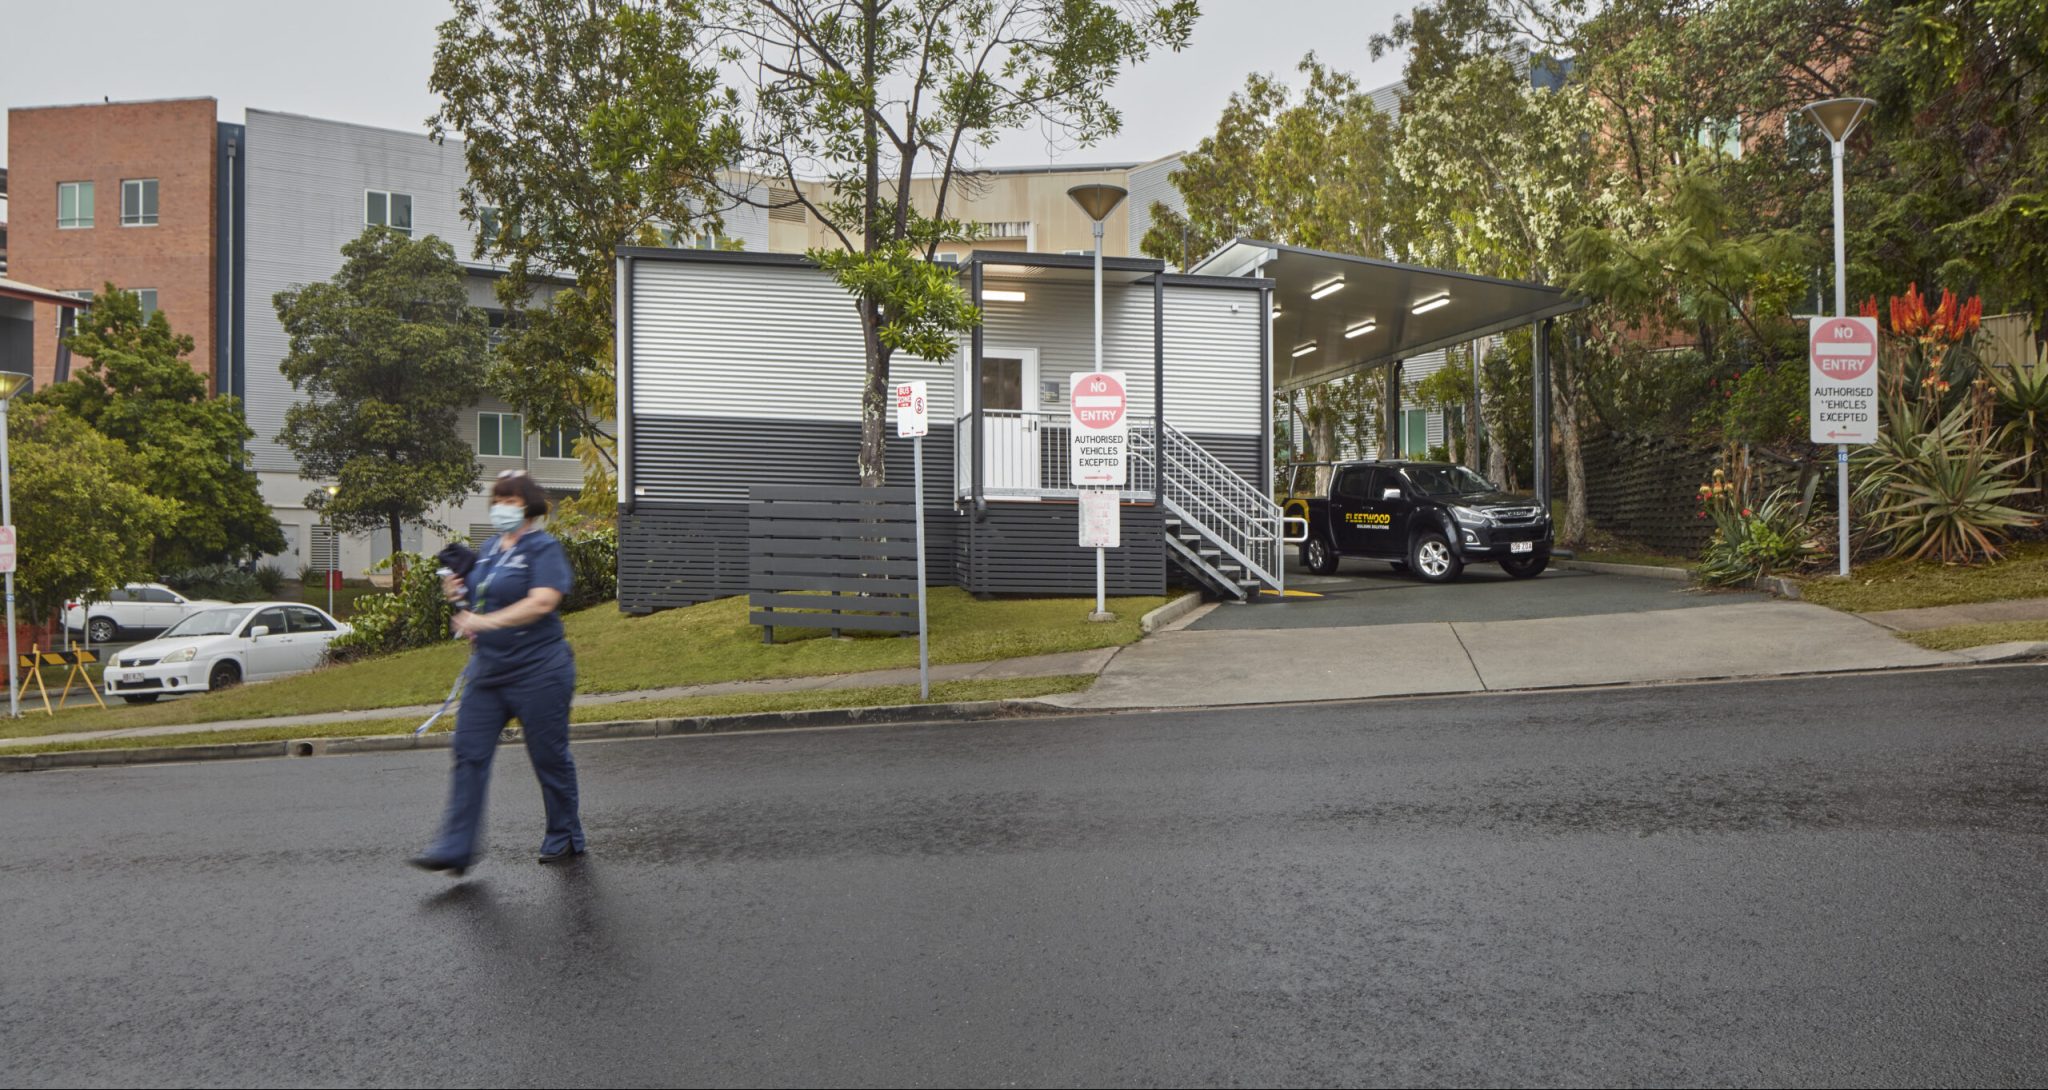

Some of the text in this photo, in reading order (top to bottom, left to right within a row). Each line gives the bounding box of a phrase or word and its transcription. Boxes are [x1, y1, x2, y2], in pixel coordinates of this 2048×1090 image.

[1833, 327, 1853, 338] NO
[1822, 359, 1865, 371] ENTRY
[1090, 382, 1107, 392] NO
[1814, 387, 1874, 397] AUTHORISED
[1821, 400, 1867, 409] EHICLES
[1080, 410, 1117, 421] ENTRY
[1819, 413, 1868, 422] EXCEPTED
[1074, 435, 1124, 444] AUTHORISED
[1080, 447, 1118, 455] VEHICLES
[1079, 458, 1119, 467] EXCEPTED
[1345, 513, 1391, 524] FLEETWOOD
